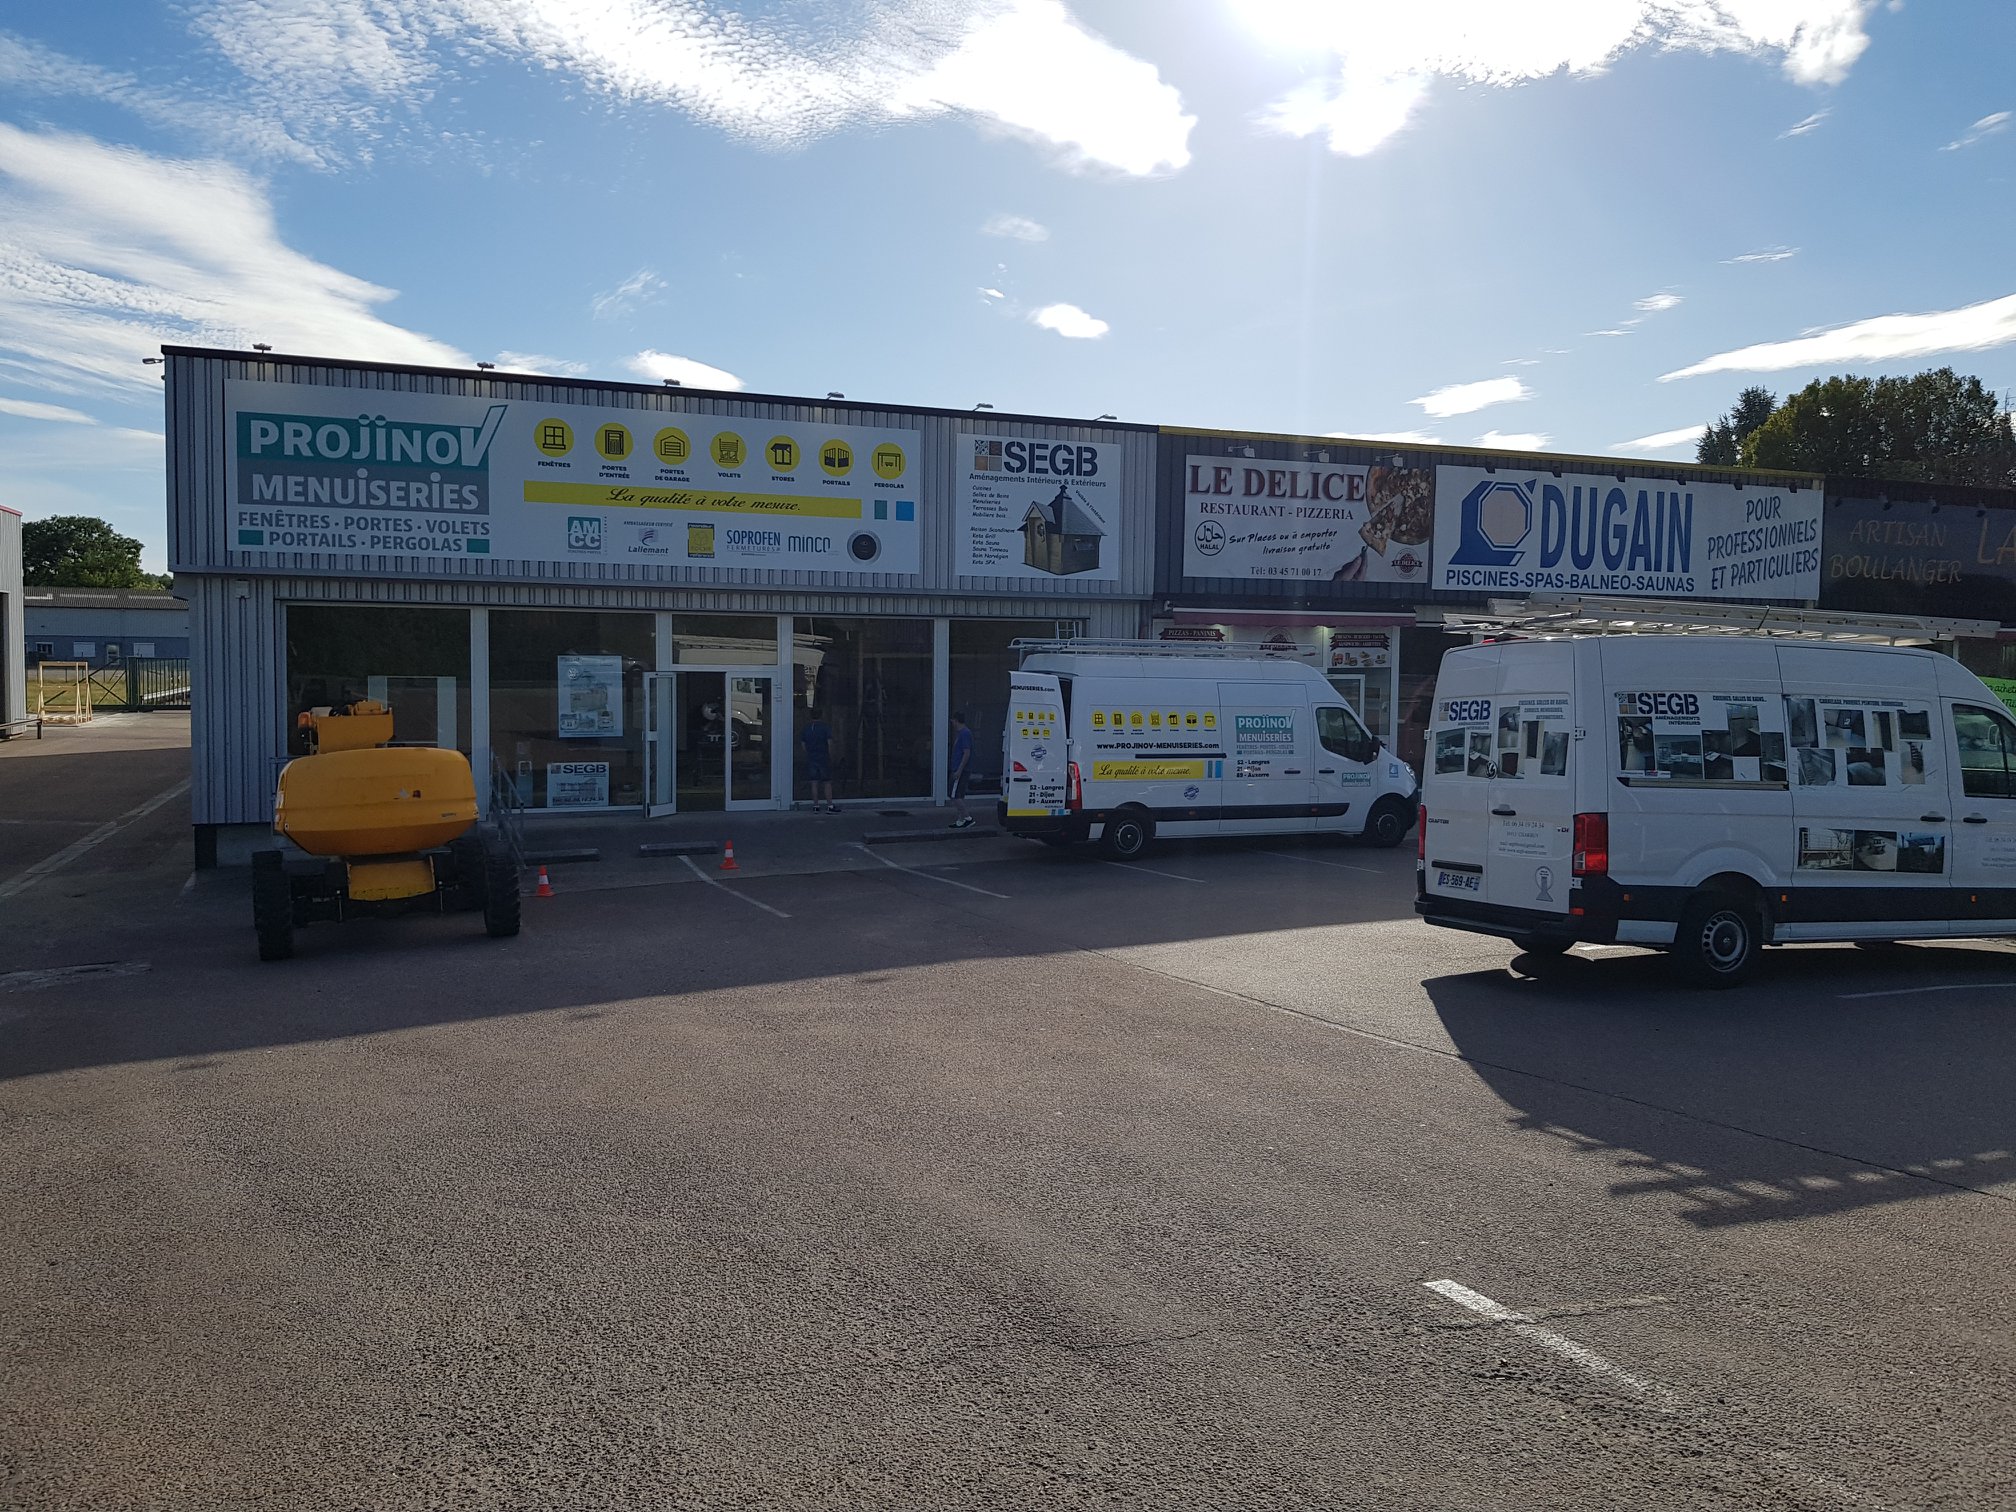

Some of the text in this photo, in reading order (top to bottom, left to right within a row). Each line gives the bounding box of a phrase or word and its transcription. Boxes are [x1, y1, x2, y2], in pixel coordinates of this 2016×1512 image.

[538, 460, 571, 468] FENÊTRES
[602, 464, 627, 472] PORTES
[1004, 441, 1098, 477] SEGB
[969, 473, 1025, 483] Aménagements
[1027, 476, 1062, 485] Intérieurs
[1071, 479, 1106, 488] Extérieurs
[1189, 464, 1366, 502] LE DELICE
[606, 488, 800, 511] La qualité à votre mesure.
[1200, 502, 1354, 520] RESTAURANT PIZZERIA
[1746, 496, 1782, 524] POUR
[238, 510, 490, 535] FENÊTRES PORTES VOLETS
[1540, 484, 1693, 573] DUGAIN
[1850, 519, 1947, 546] ARTISAN
[269, 532, 462, 552] PORTAILS PERGOLAS
[726, 530, 780, 546] SOPROFEN
[1229, 528, 1338, 545] Sur Places ou à emporter
[1707, 518, 1818, 561] PROFESSIONNELS
[628, 546, 669, 554] Lallemant
[1262, 544, 1331, 556] livraison gratuite
[1268, 567, 1278, 576] 03
[1279, 567, 1289, 576] 45
[1290, 568, 1299, 576] 71
[1302, 568, 1310, 576] 00
[1313, 568, 1322, 576] 17
[1711, 548, 1818, 590] ET PARTICULIERS
[1829, 554, 1962, 584] BOULANGER
[1449, 700, 1491, 722] SEGB
[1638, 693, 1700, 715] SEGB
[1096, 742, 1220, 750] www.PROJINOV-MENUISERIES.com
[563, 764, 606, 774] SEGB
[1099, 764, 1112, 776] La
[1114, 765, 1140, 778] qualité
